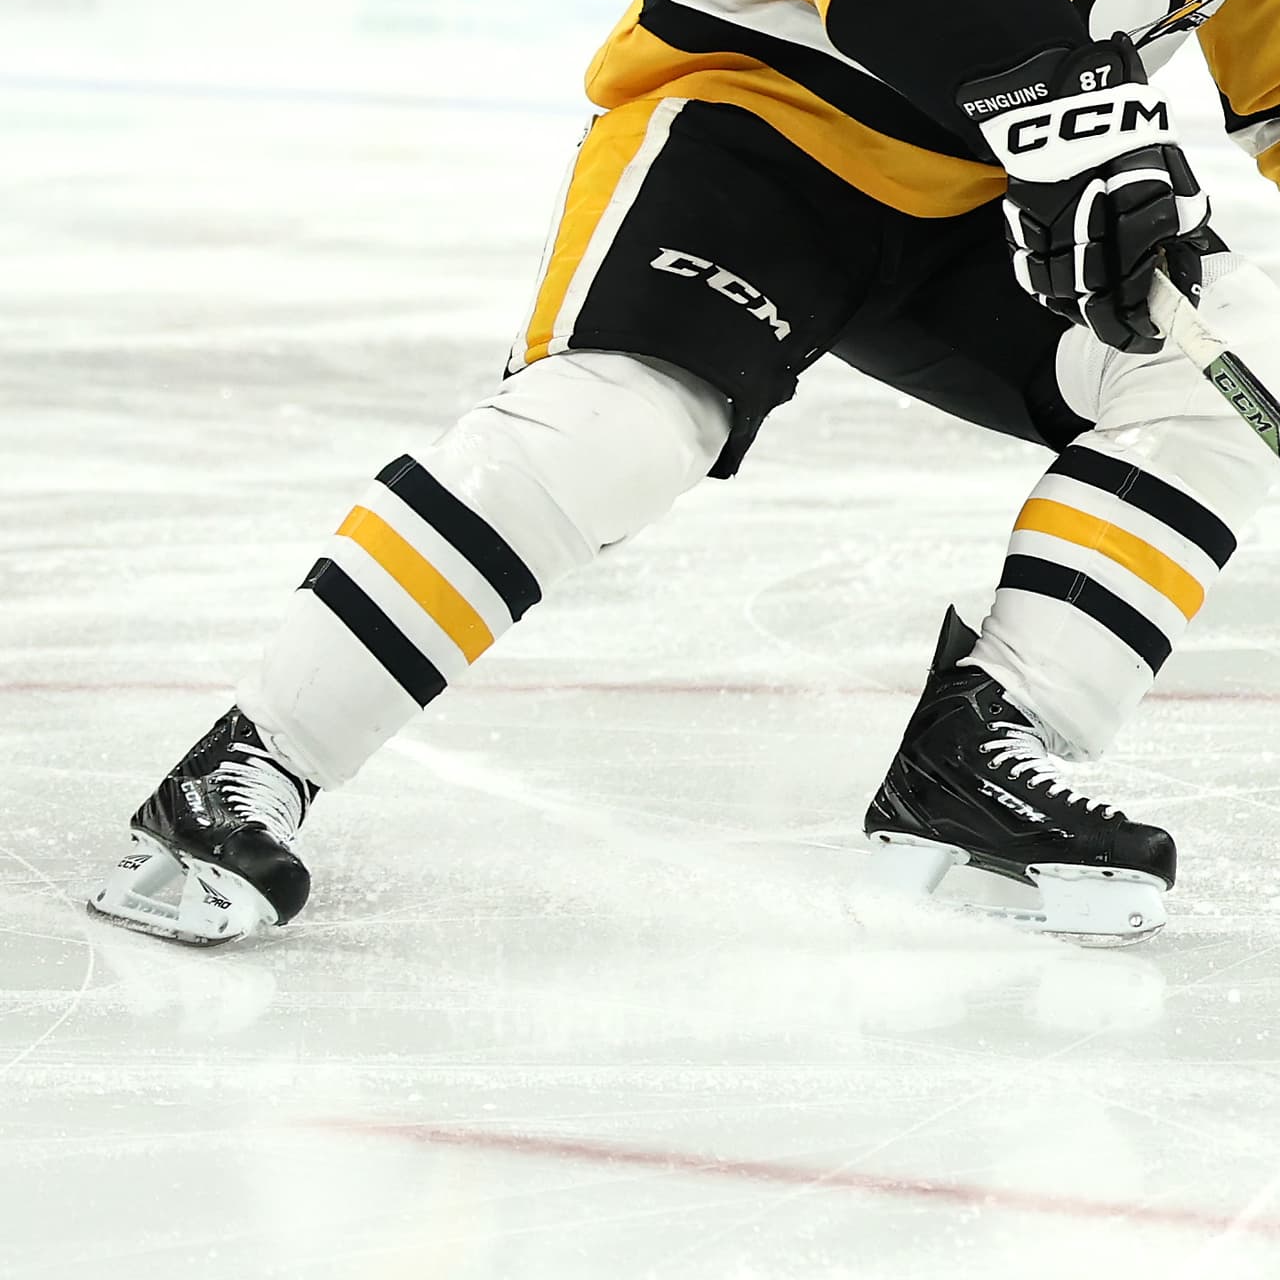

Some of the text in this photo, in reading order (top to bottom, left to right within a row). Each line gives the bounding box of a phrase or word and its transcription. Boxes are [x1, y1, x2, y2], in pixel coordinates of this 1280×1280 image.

[963, 83, 1049, 116] PENGUINS
[1079, 64, 1112, 91] 87
[1008, 100, 1169, 155] CCM
[650, 247, 791, 341] CCM
[1213, 369, 1275, 434] CCM
